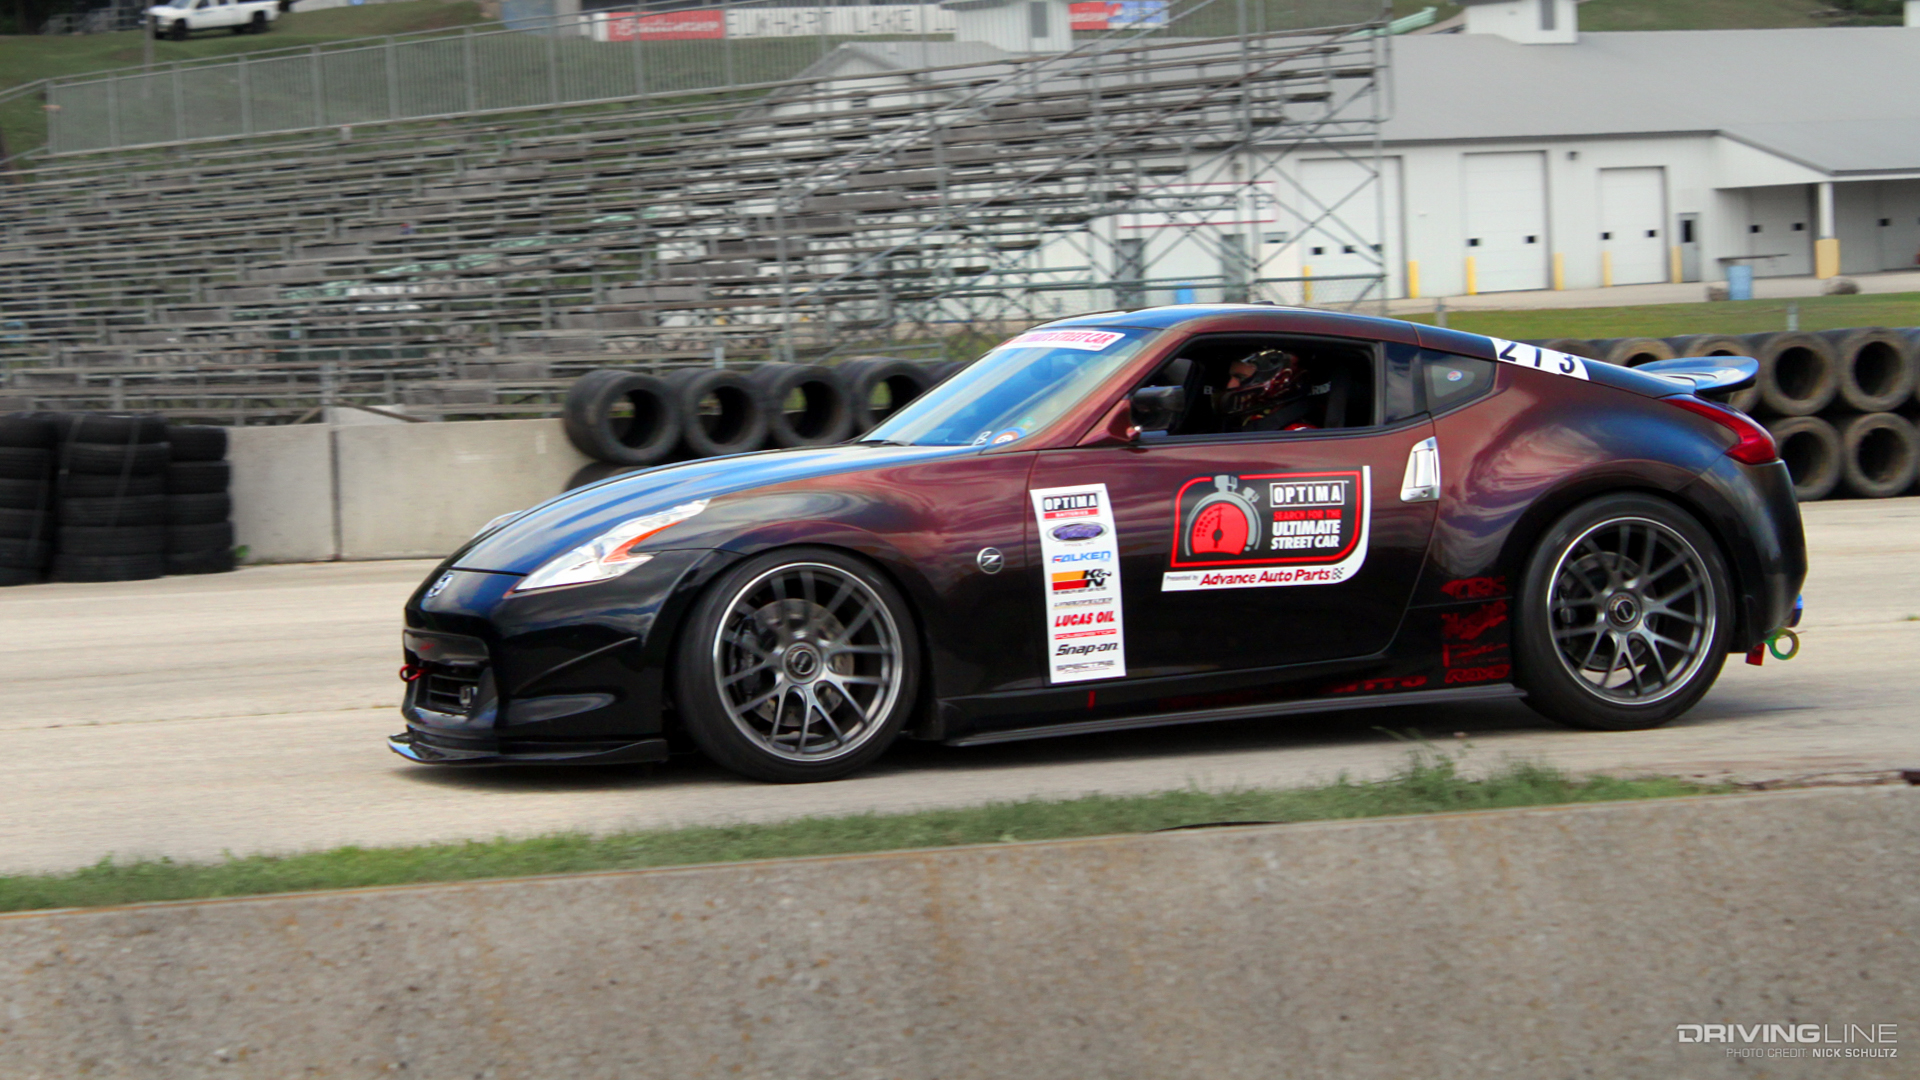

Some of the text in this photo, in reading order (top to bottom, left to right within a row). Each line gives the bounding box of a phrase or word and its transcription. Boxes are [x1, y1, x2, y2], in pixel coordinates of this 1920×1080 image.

[1084, 332, 1116, 345] CAR
[1044, 493, 1097, 511] OPTIMA
[1273, 485, 1341, 503] OPTIMA
[1273, 509, 1342, 521] SEARCH FOR THE
[1272, 519, 1341, 536] ULTIMATE
[1270, 535, 1340, 550] STREET CAR
[1051, 550, 1112, 563] FALKEN
[1199, 568, 1331, 586] Advance Auto Parts
[1054, 610, 1116, 628] LUCAS OIL
[1055, 642, 1119, 656] Snap-on
